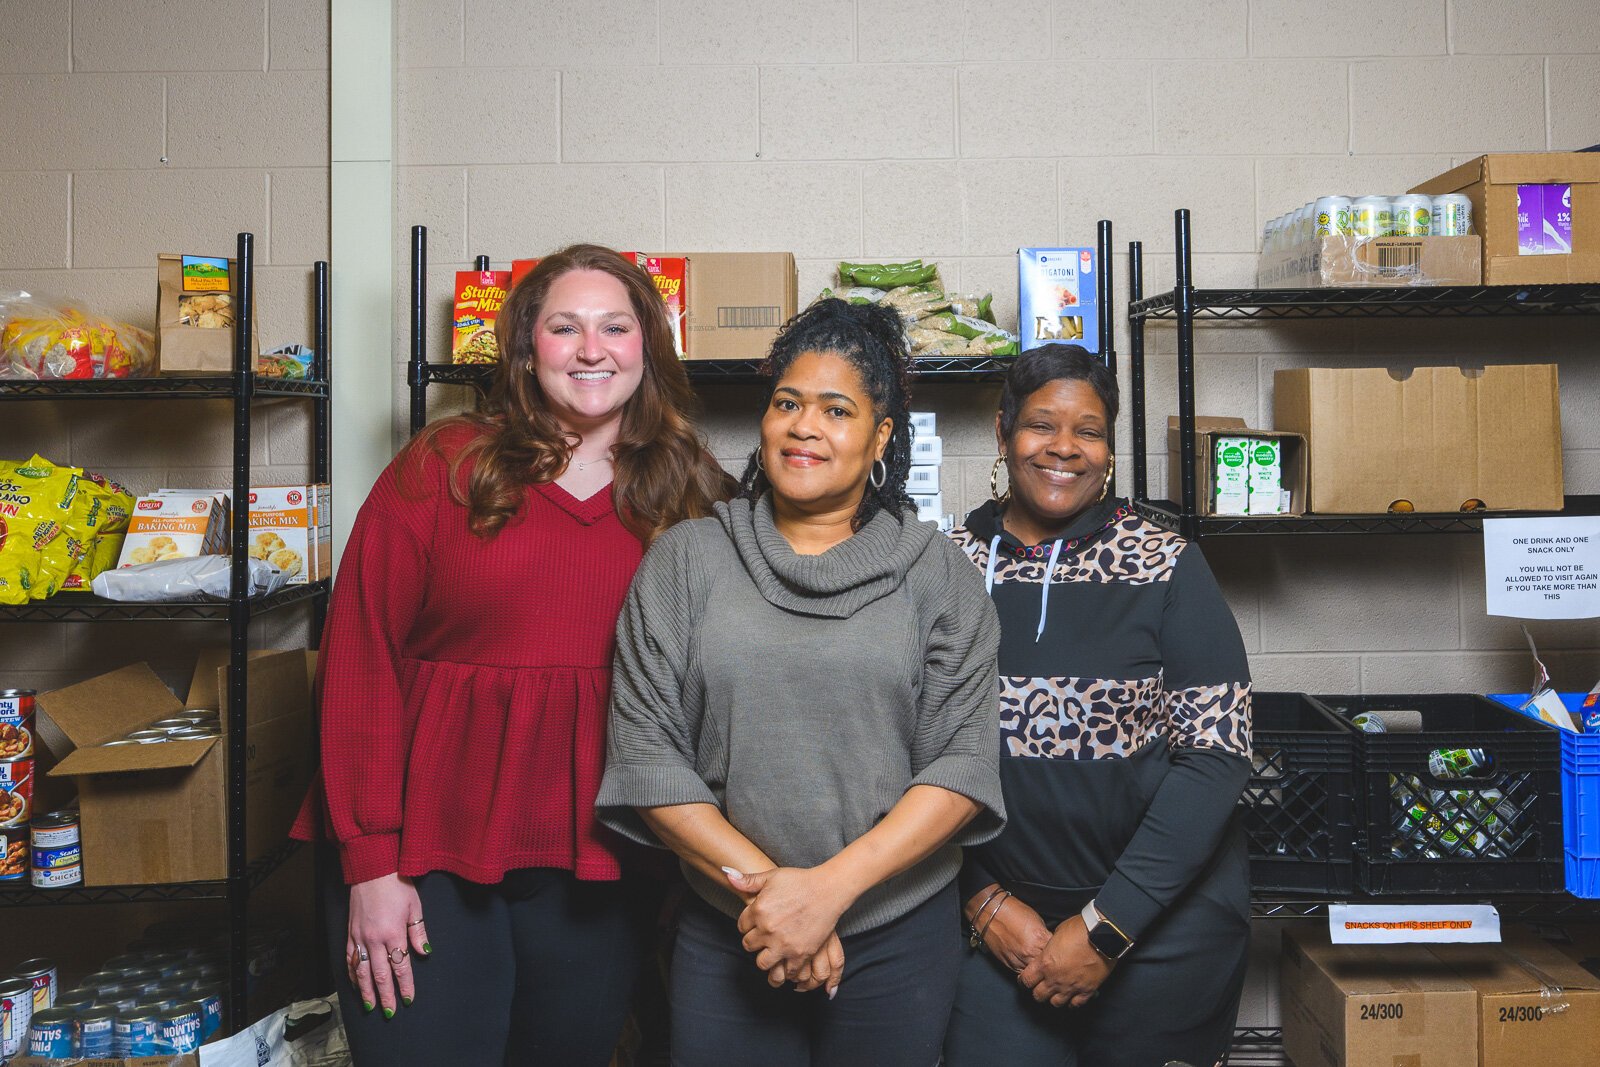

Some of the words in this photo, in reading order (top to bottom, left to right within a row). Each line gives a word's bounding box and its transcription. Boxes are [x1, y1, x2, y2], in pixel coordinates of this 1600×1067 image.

[461, 285, 507, 300] Stuffin
[476, 298, 502, 311] Mix
[280, 516, 299, 525] MIX
[137, 522, 176, 531] BAKING
[177, 523, 198, 531] MIX
[60, 847, 80, 857] StarK
[1345, 921, 1381, 929] SNACKS
[1382, 921, 1396, 929] ON
[1397, 921, 1418, 929] THIS
[1419, 921, 1447, 929] SHELF
[1449, 920, 1472, 929] ONLY
[1360, 1003, 1403, 1020] 24/300
[1499, 1005, 1543, 1022] 24/300
[31, 1041, 52, 1052] PINK
